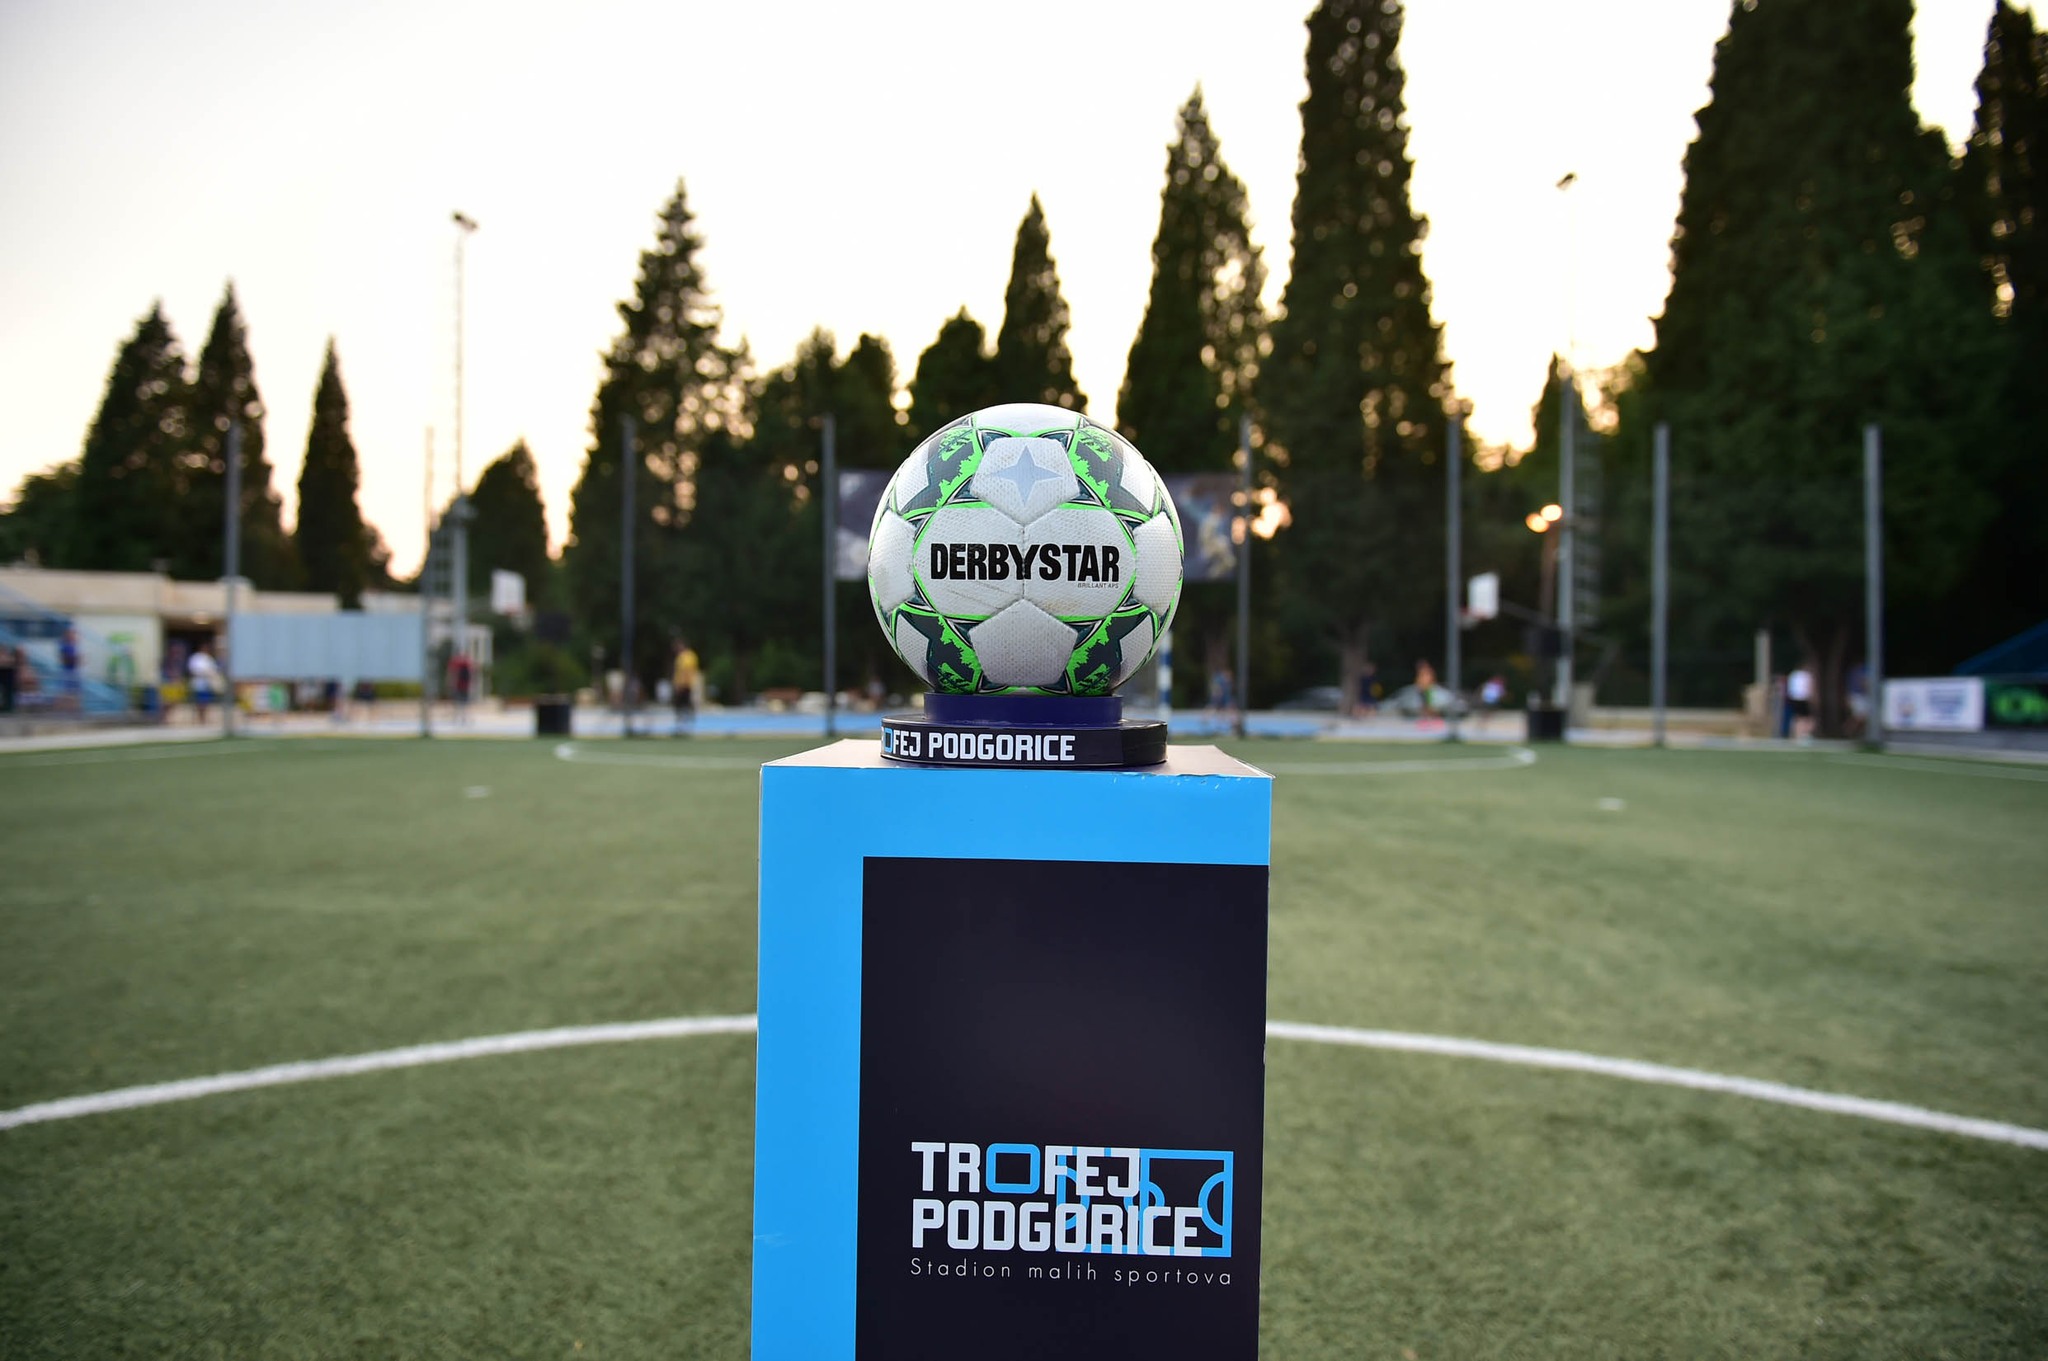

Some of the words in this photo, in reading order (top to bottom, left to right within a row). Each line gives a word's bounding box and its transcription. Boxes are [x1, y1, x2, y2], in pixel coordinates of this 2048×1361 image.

[930, 543, 1120, 582] DERBYSTAR
[881, 727, 921, 757] OFEJ
[928, 732, 1076, 761] PODGORICE
[911, 1141, 1140, 1197] TROFEJ
[912, 1199, 1203, 1257] PODGORICE
[910, 1257, 1011, 1279] Stadion
[1028, 1261, 1097, 1281] malih
[1114, 1267, 1232, 1287] sportova
